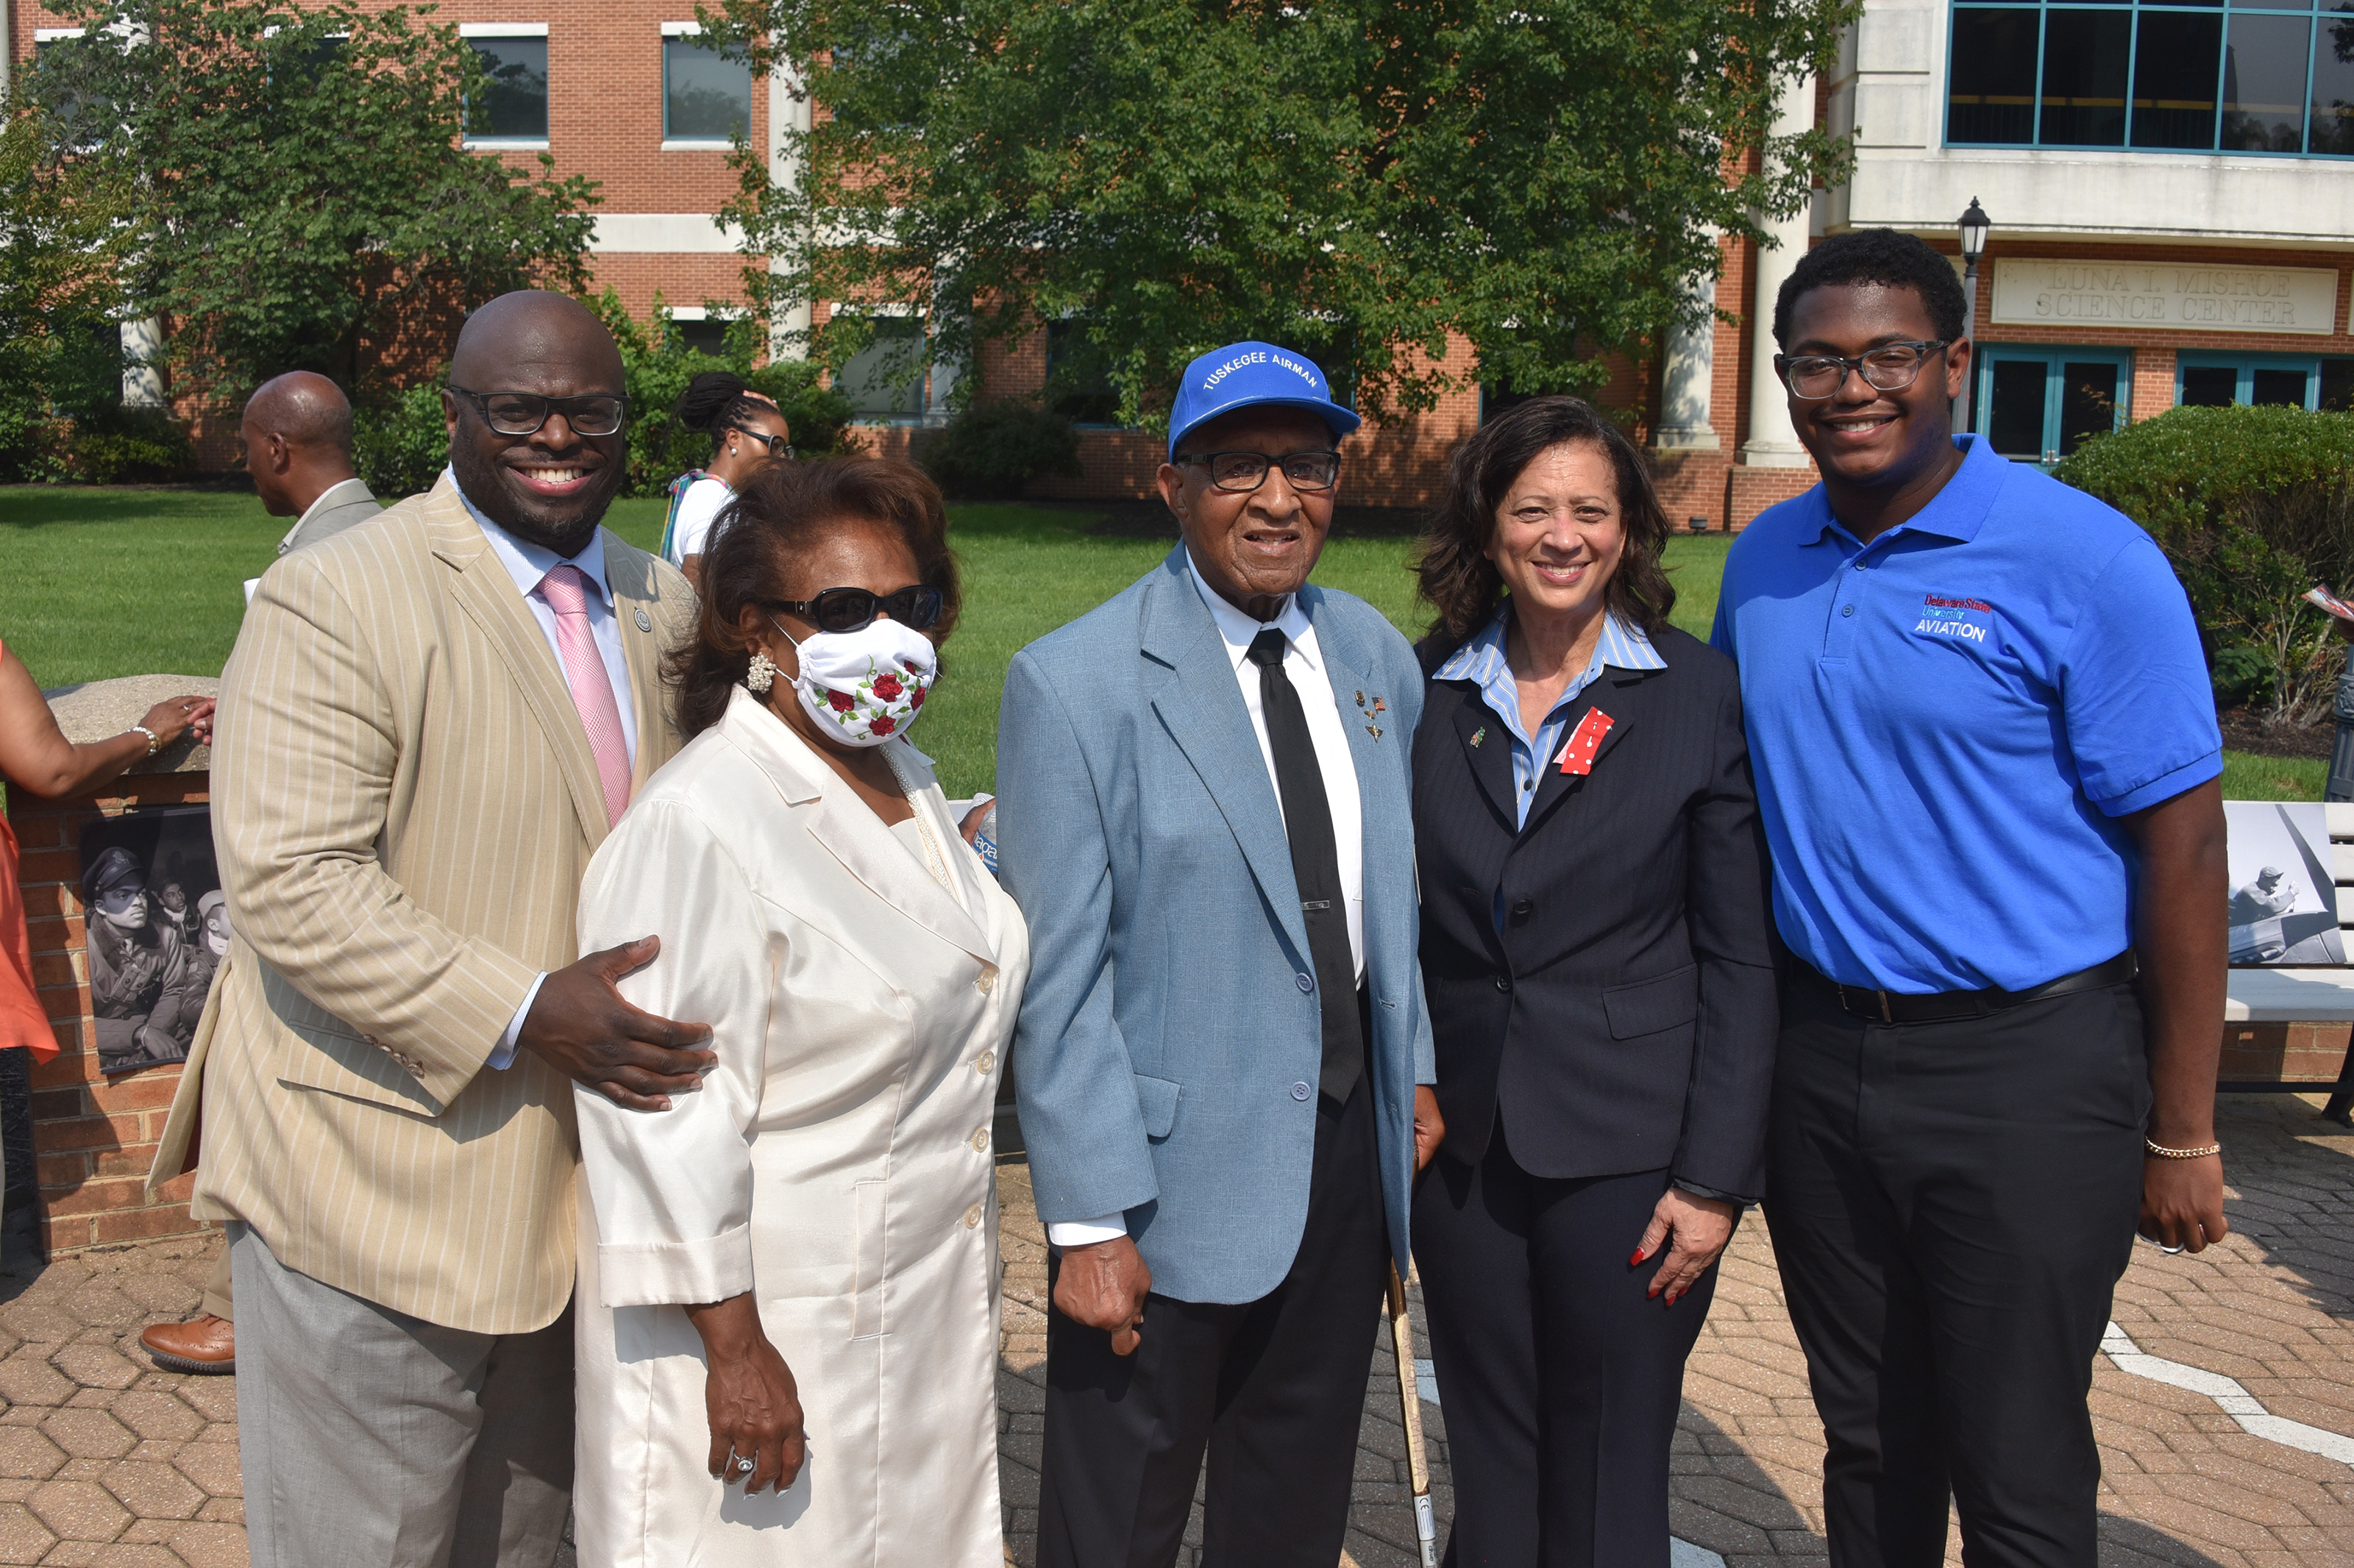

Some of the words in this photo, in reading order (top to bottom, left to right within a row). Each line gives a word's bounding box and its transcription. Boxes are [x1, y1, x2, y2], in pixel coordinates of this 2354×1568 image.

[2047, 267, 2130, 292] LUNA
[2143, 269, 2161, 293] I.
[2174, 271, 2291, 298] MISHOE
[2035, 293, 2166, 320] SCIENCE
[2182, 297, 2297, 325] CENTER
[1203, 352, 1267, 391] TUSKEGEE
[1272, 354, 1318, 388] AIRMAN
[1922, 606, 1966, 620] University
[1924, 594, 1965, 608] Delaware
[1964, 597, 1991, 614] State
[1915, 619, 1986, 644] AVIATION
[1409, 1413, 1427, 1478] NATHAN
